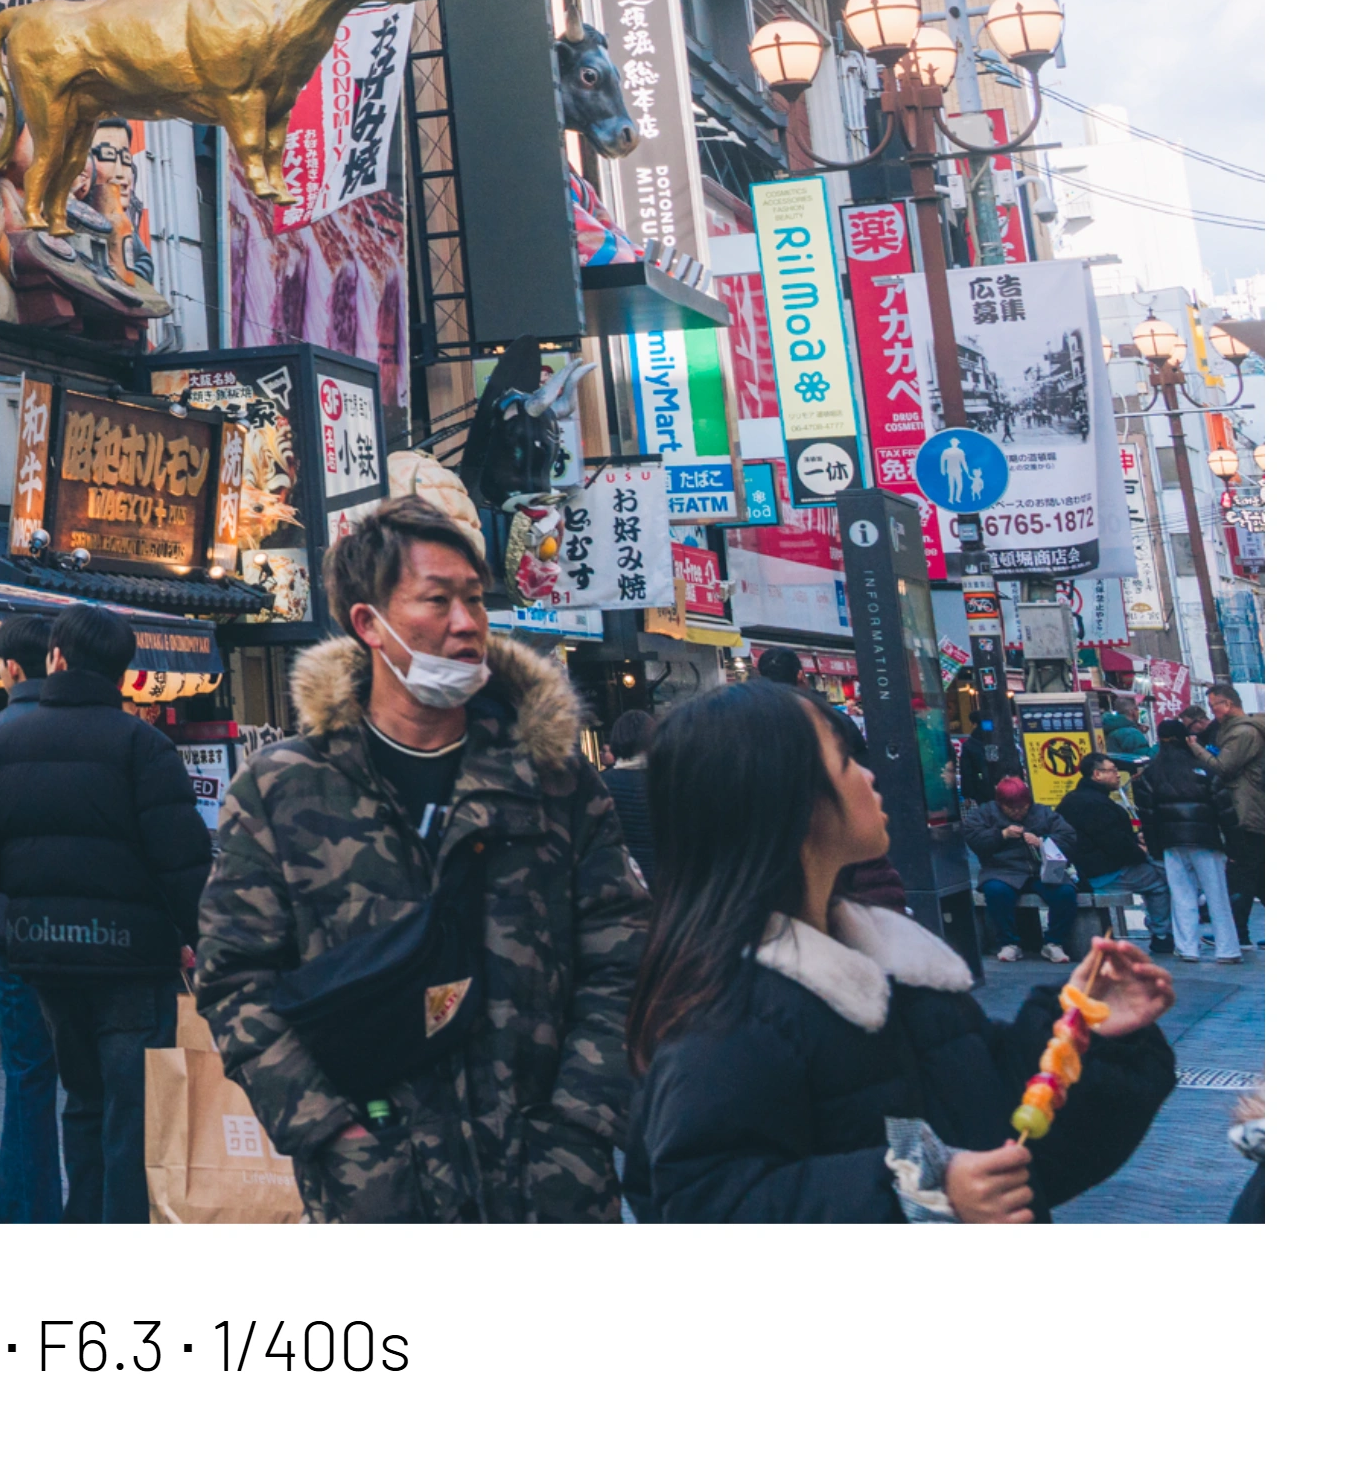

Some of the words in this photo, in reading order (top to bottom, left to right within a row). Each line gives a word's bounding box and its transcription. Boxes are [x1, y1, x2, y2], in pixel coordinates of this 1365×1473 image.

[847, 210, 901, 255] 薬
[772, 225, 827, 363] Rilmoa
[968, 274, 1023, 301] 広告
[972, 298, 1026, 325] 募集
[189, 371, 237, 388] 大阪名物
[322, 383, 341, 416] 3F
[892, 412, 919, 422] DRUG
[18, 389, 48, 514] 和牛
[62, 410, 211, 498] 昭和ホルモン
[879, 449, 901, 458] TAX
[1005, 451, 1057, 464] 期の道頓堀
[218, 430, 244, 540] 焼肉
[679, 471, 724, 488] たばこ
[803, 461, 849, 482] 一休
[87, 486, 155, 525] WAGYU
[564, 505, 595, 591] どむす
[612, 487, 648, 602] お好み焼
[863, 569, 890, 701] INFORMATION
[13, 914, 132, 949] Columbia
